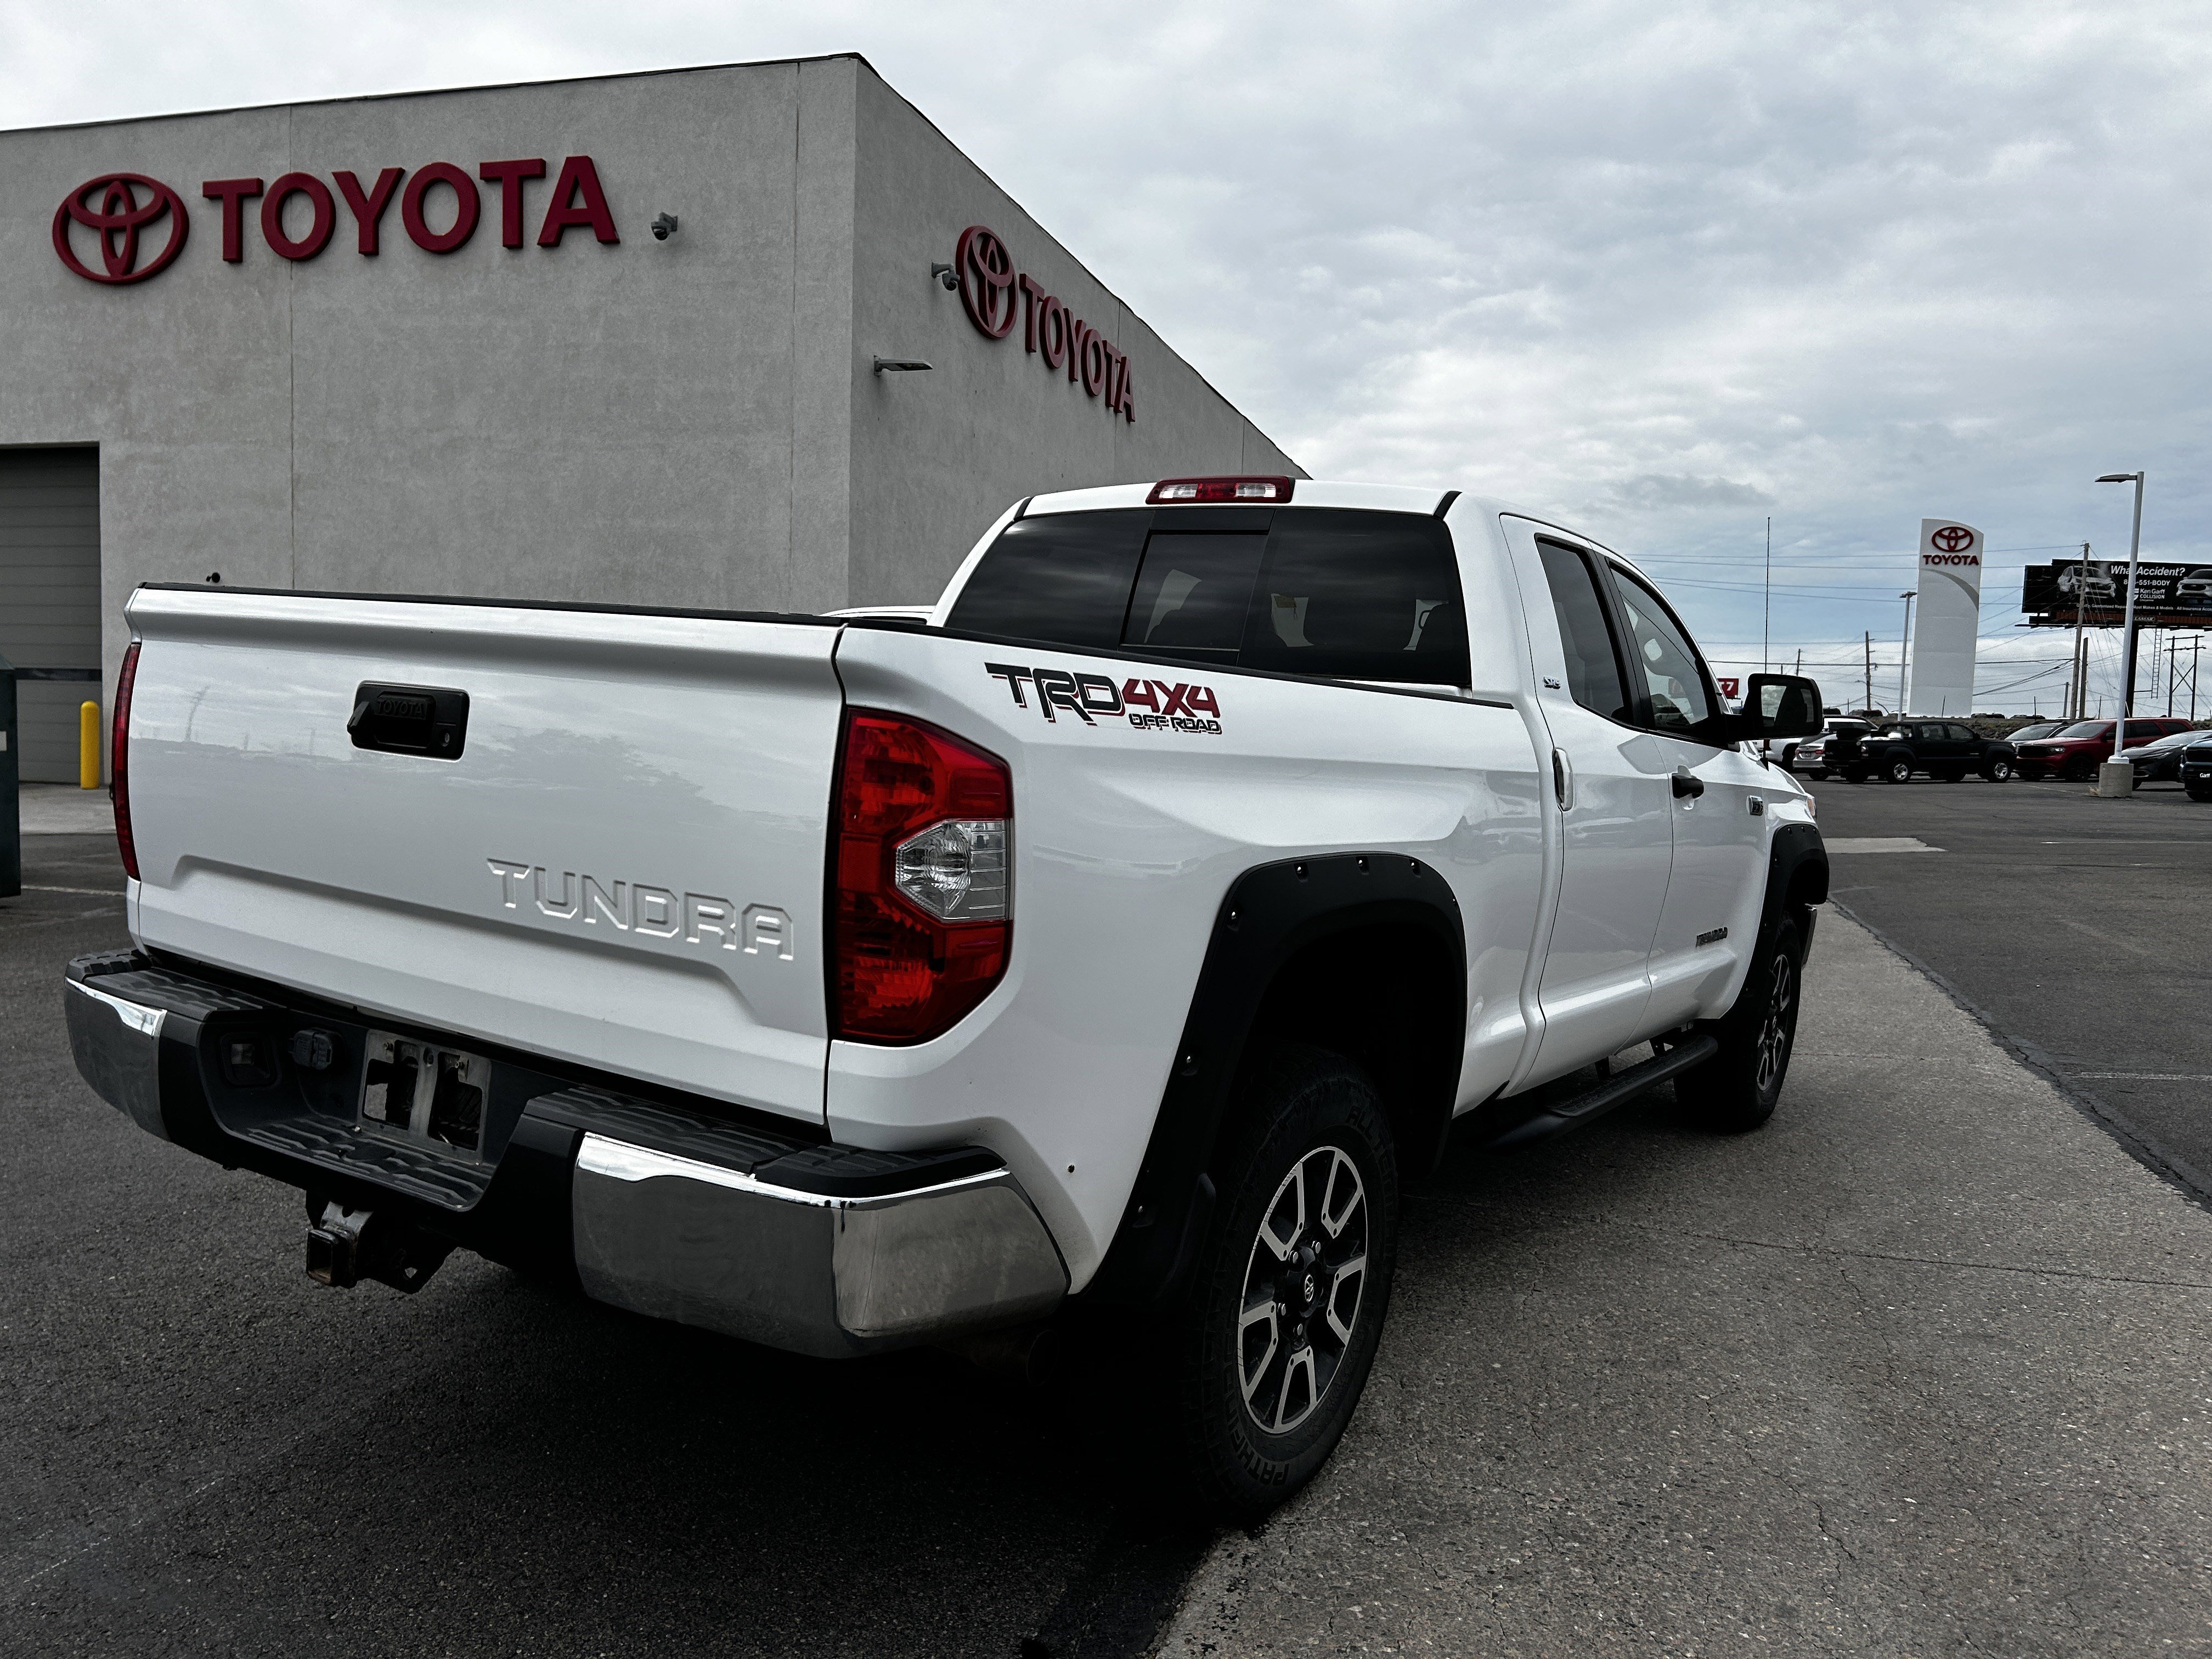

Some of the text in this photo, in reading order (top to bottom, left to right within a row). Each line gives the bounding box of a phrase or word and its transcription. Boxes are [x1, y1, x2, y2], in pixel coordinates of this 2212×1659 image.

[202, 155, 620, 262] TOYOTA
[1019, 273, 1136, 422] TOYOTA
[1923, 555, 1979, 566] TOYOTA
[2111, 566, 2186, 576] Wha Accident?
[377, 700, 424, 716] TOYOTA
[985, 662, 1221, 725] TRD 4X4
[487, 857, 794, 961] TUNDRA
